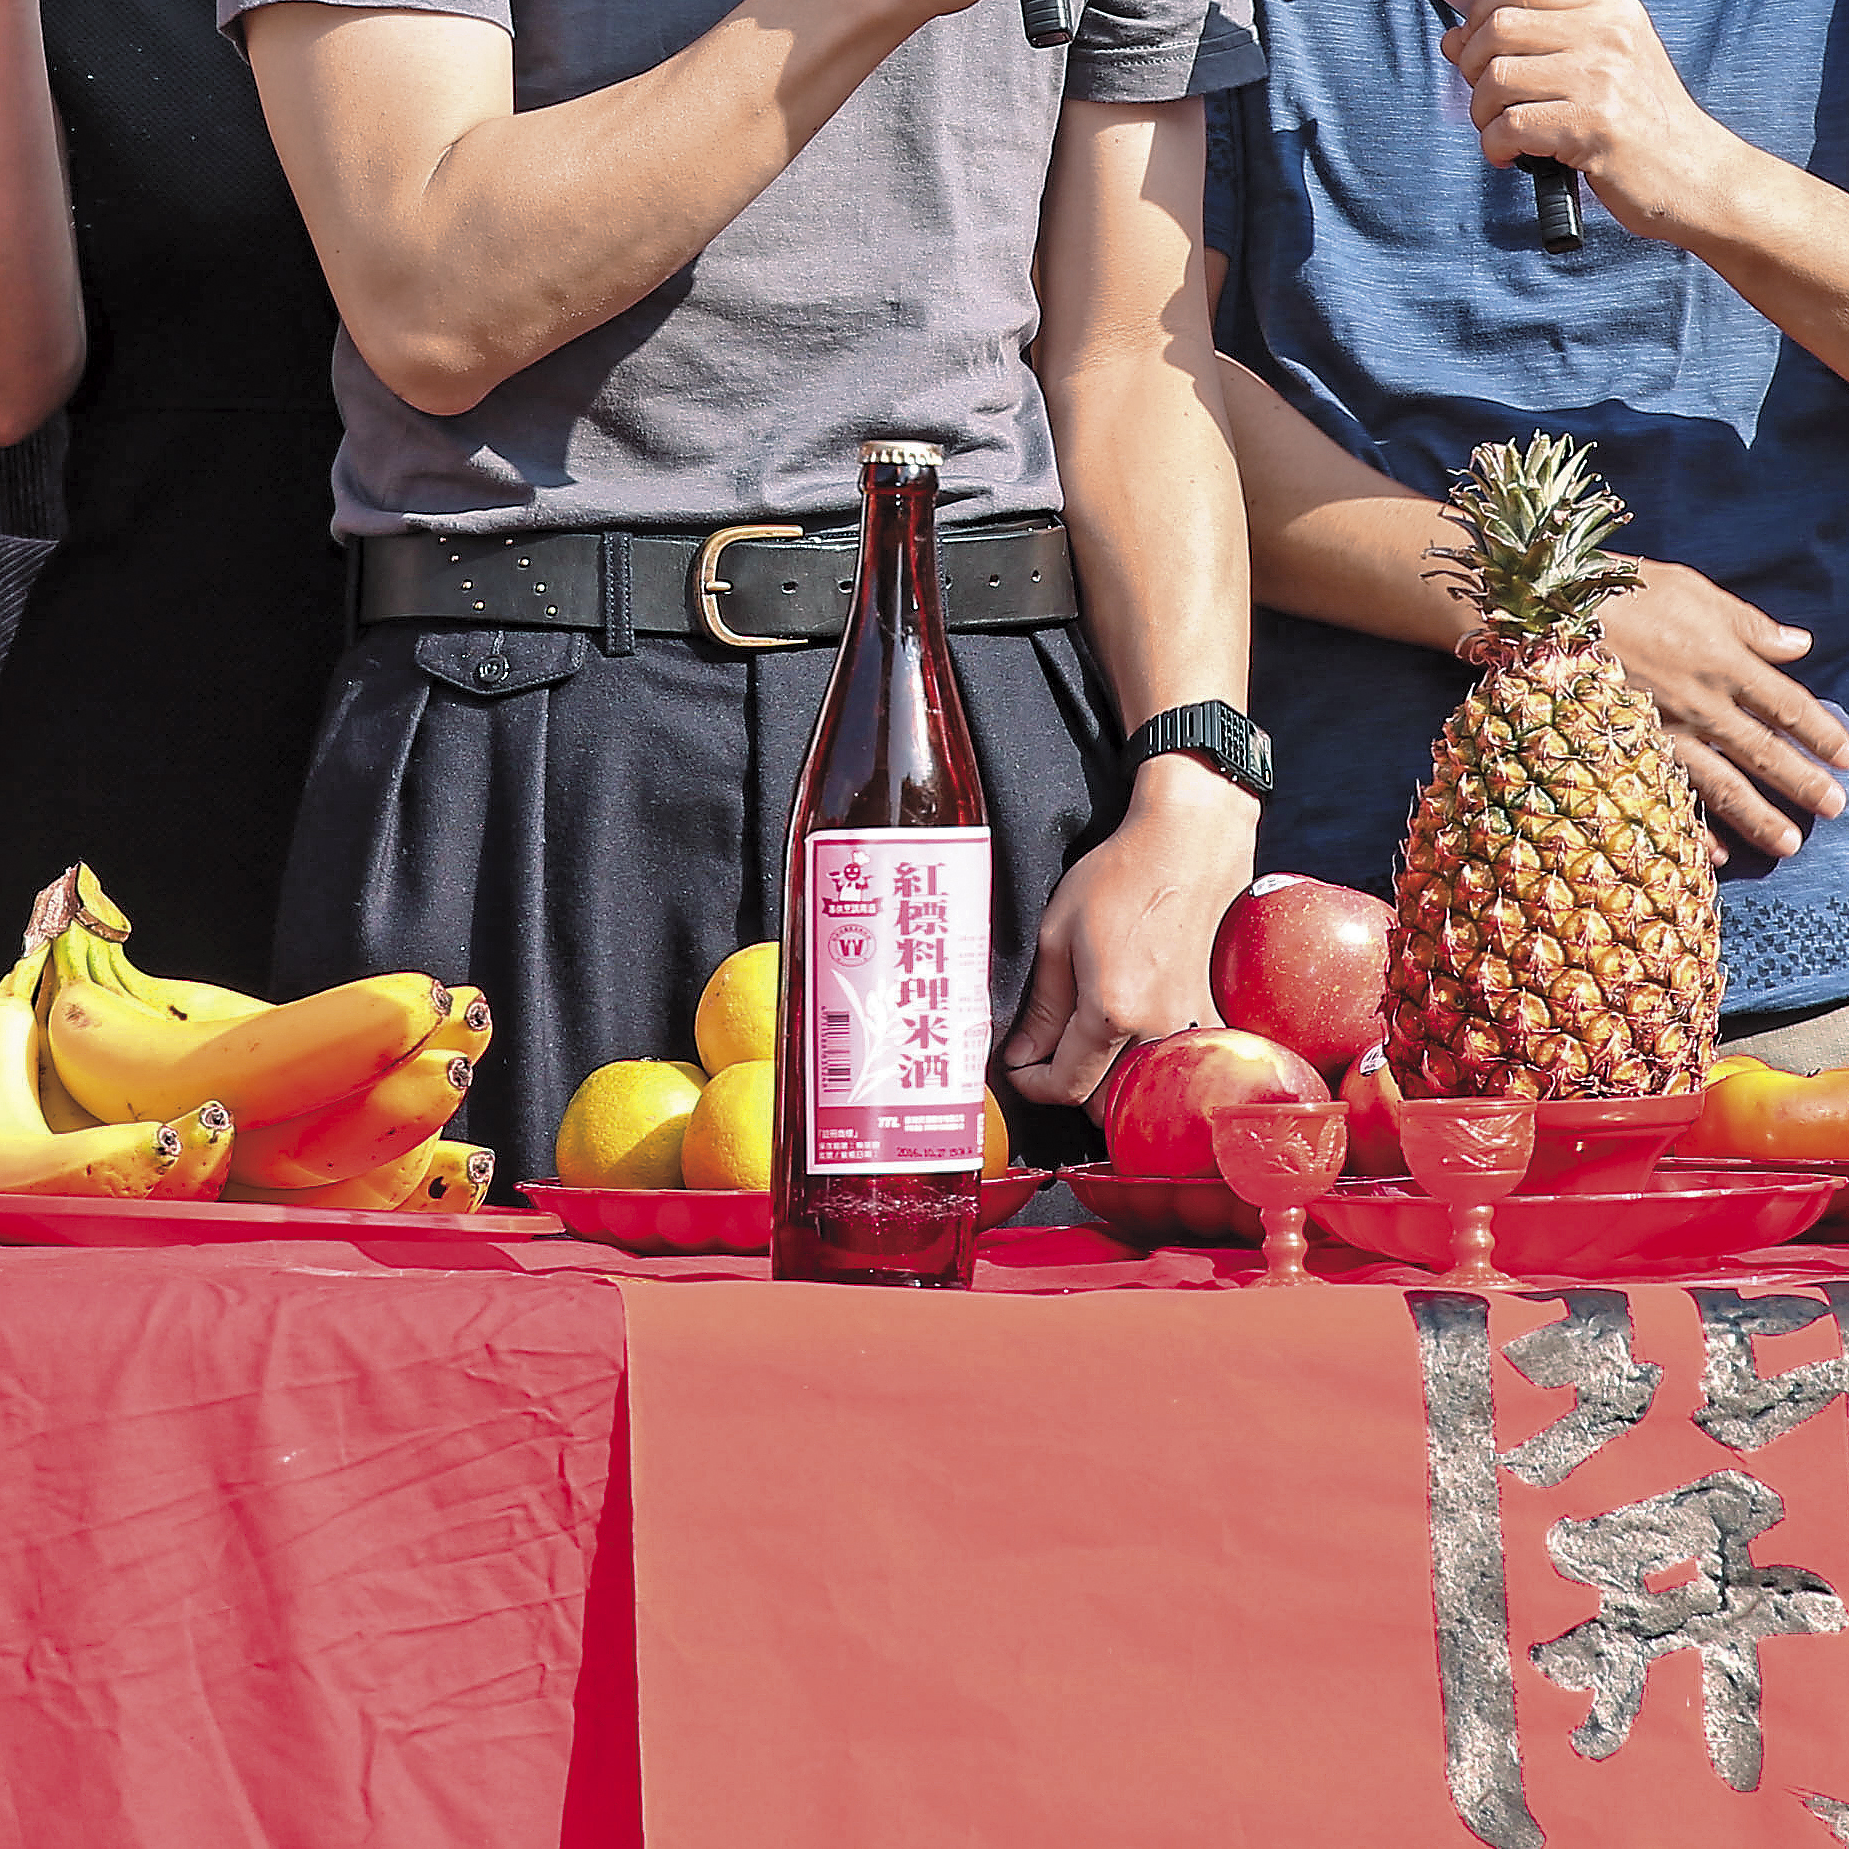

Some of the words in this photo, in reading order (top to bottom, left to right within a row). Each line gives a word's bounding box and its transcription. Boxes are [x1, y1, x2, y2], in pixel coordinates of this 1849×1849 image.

[892, 861, 950, 1091] 紅標料理米酒
